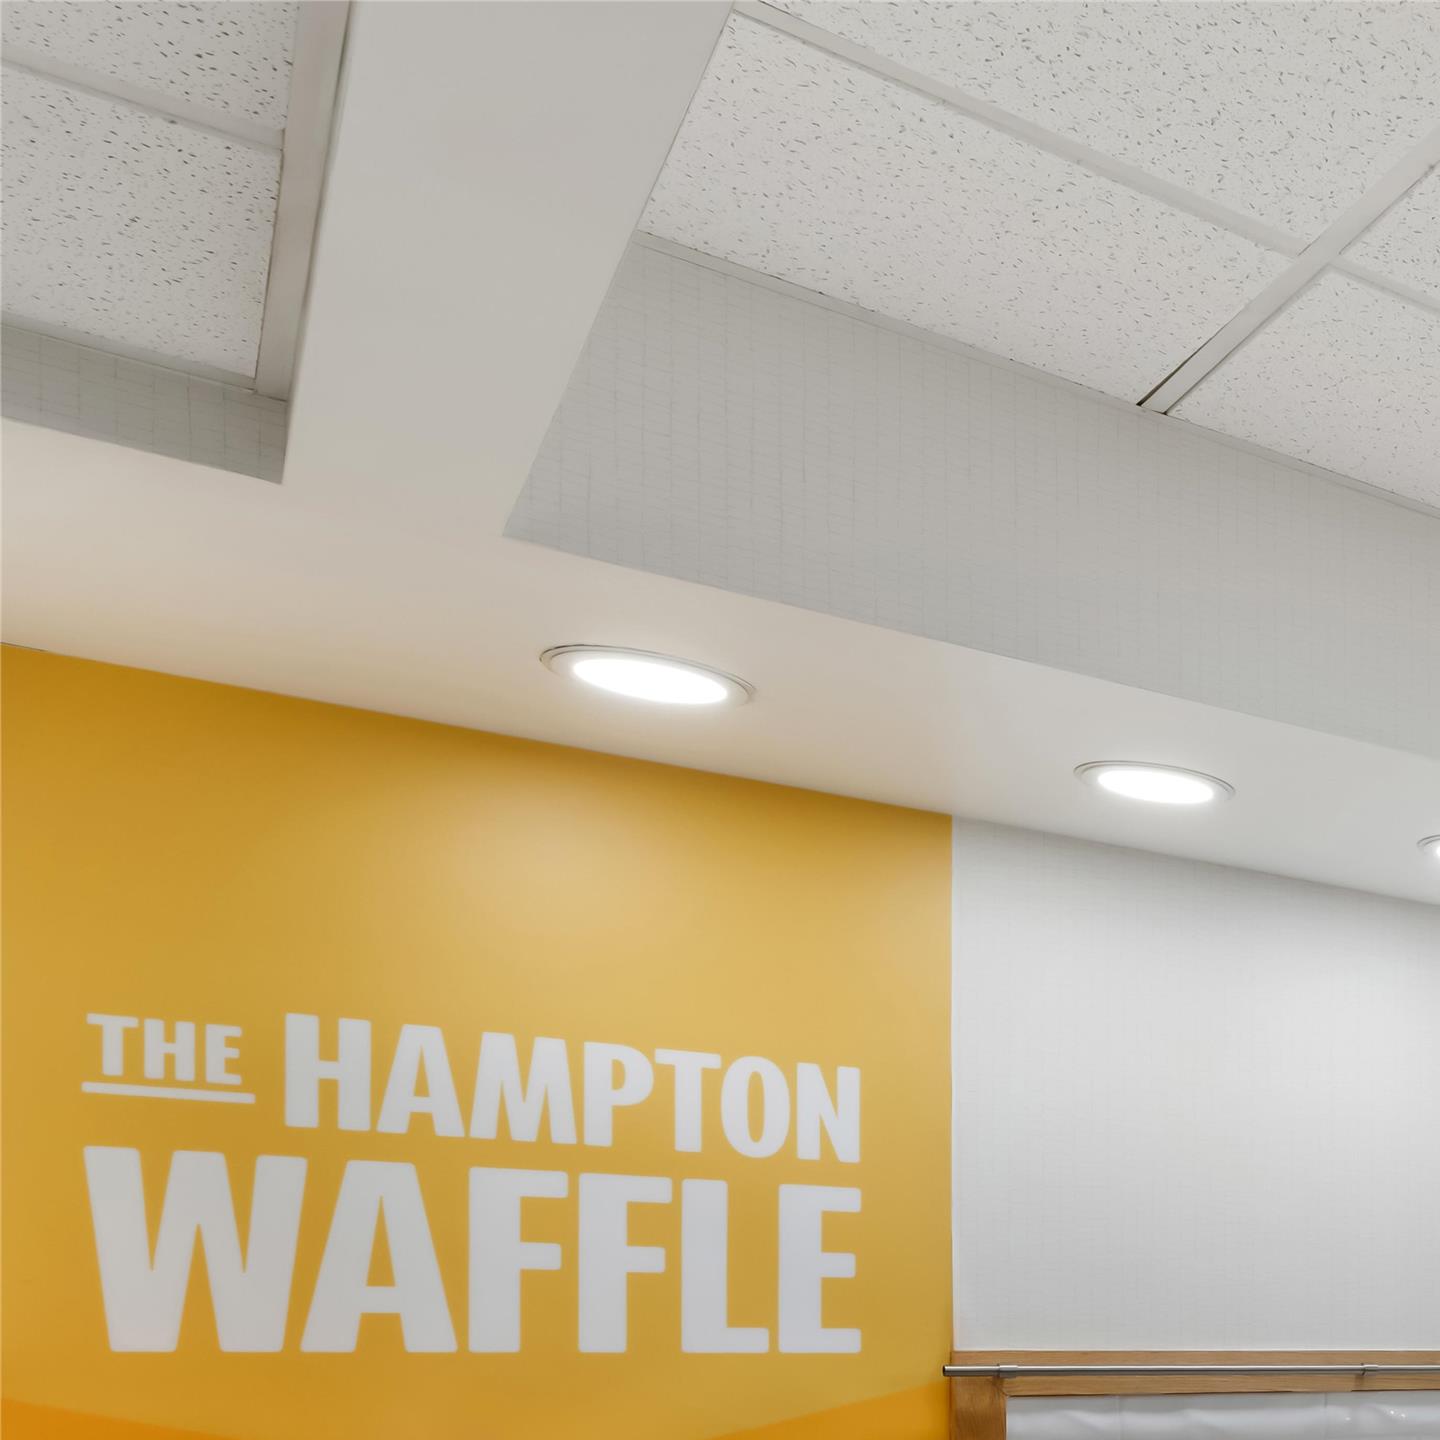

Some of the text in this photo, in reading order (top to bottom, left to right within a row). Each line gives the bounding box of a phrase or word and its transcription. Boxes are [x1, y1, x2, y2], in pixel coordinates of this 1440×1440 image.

[86, 1013, 861, 1163] THE HAMPTON
[83, 1146, 862, 1353] WAFFLE
